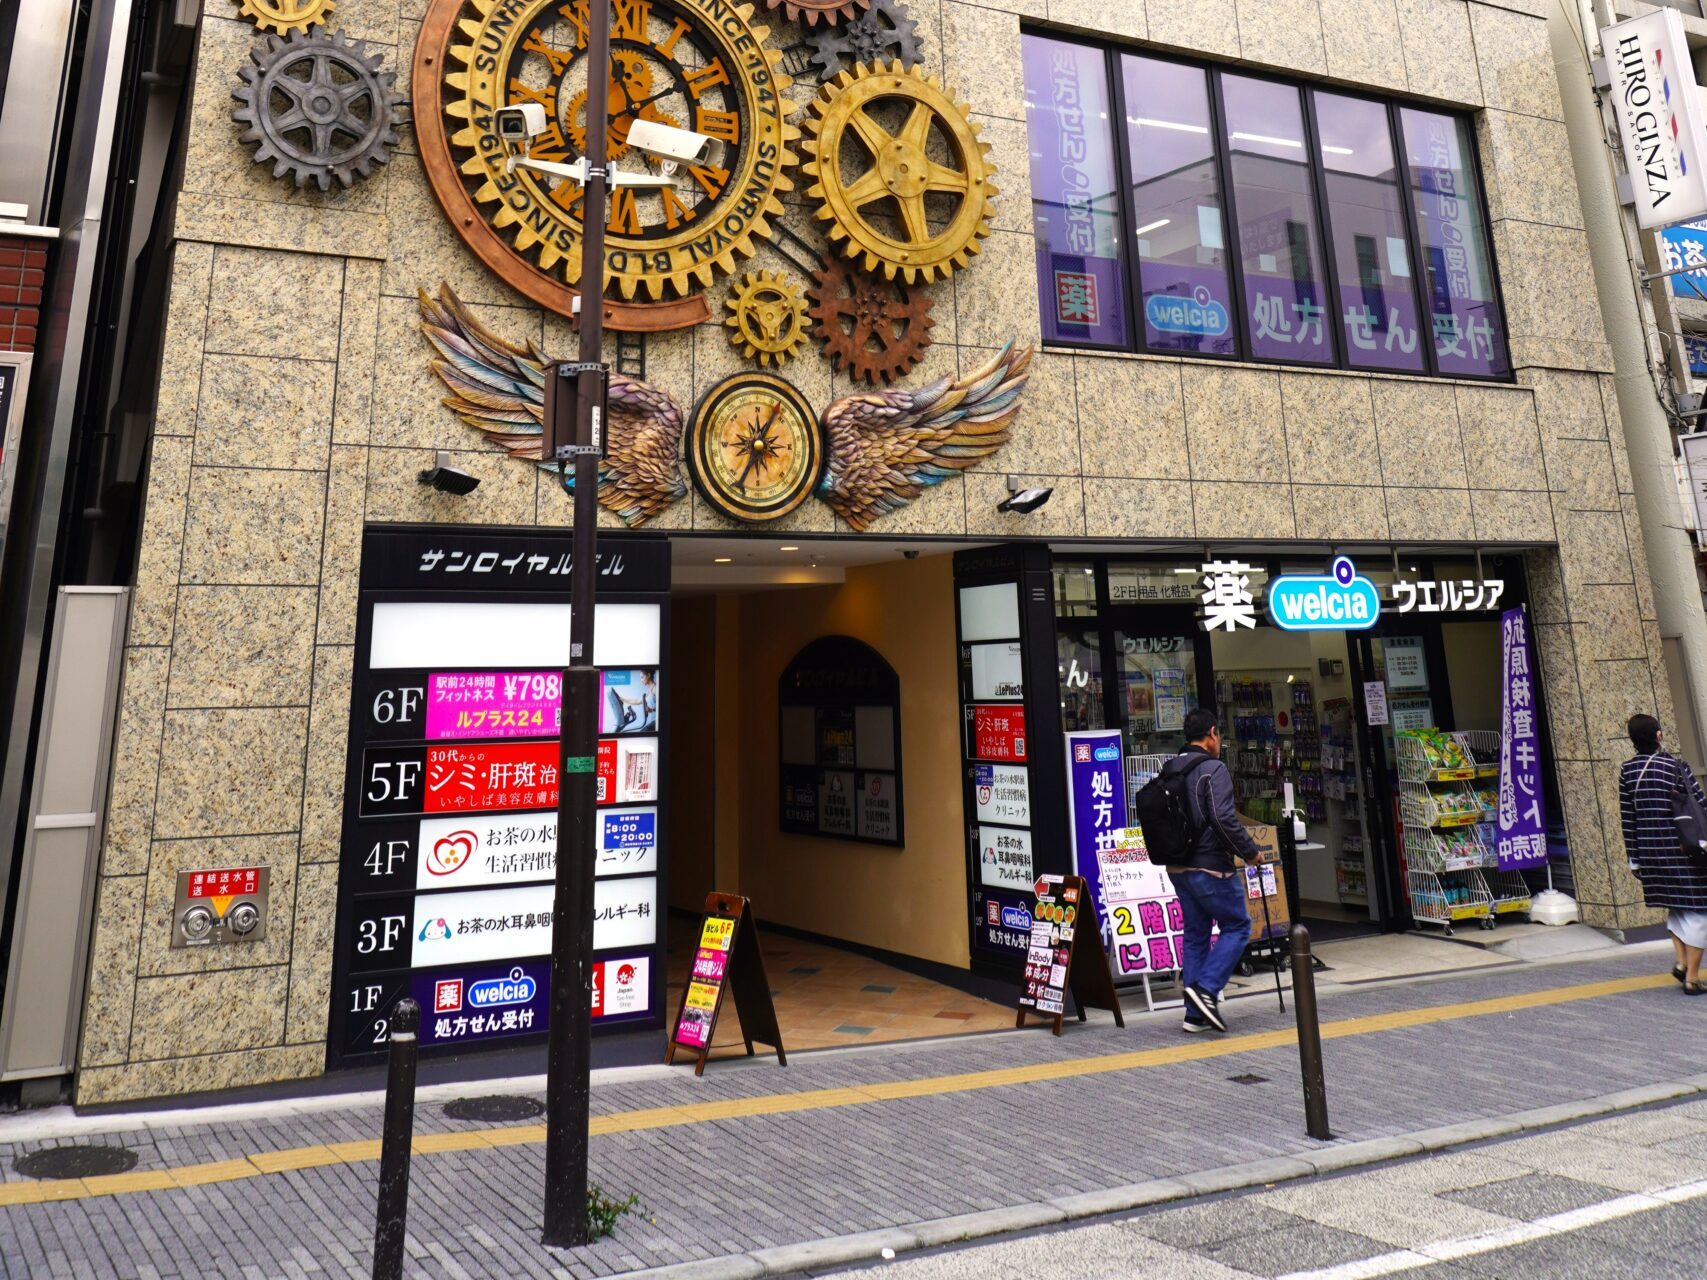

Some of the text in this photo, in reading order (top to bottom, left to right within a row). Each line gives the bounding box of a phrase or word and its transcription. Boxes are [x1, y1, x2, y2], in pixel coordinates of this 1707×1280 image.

[746, 57, 777, 119] 1947
[1615, 48, 1642, 161] HAIR SALON
[471, 98, 505, 167] 1947
[1619, 33, 1651, 107] HIRO
[1635, 111, 1671, 208] GINZA
[494, 174, 576, 253] SINCE
[678, 140, 777, 263] SUNROYAL
[607, 251, 673, 274] BLD
[1060, 277, 1095, 319] 薬
[1154, 302, 1220, 328] welcia
[419, 549, 624, 576] サンロイヤルル
[1201, 560, 1504, 632] 薬 welcia ウエルシア
[1122, 636, 1185, 654] ウエルシア
[436, 688, 495, 702] フィットネス
[504, 675, 562, 701] ¥798
[373, 687, 424, 724] 6F
[456, 710, 543, 729] ルプラス24
[430, 750, 485, 762] 30代からの
[1077, 746, 1119, 761] 薬 welcia
[367, 761, 421, 802] 5F
[430, 762, 557, 791] シミ・肝斑治
[995, 805, 1027, 818] クリニック
[486, 824, 557, 847] お茶の水
[611, 824, 637, 832] 8:00
[997, 835, 1023, 851] お茶の水
[363, 841, 410, 876] 4F
[193, 871, 255, 885] 連結送水管
[999, 868, 1032, 884] アレルギー科
[1105, 871, 1144, 882] キットカット
[1004, 910, 1030, 927] welcia
[357, 916, 406, 953] 3F
[1028, 950, 1051, 965] InBody
[350, 984, 383, 1013] 1F
[438, 981, 530, 1009] 薬 welcia
[434, 1009, 535, 1038] 処方せん受付
